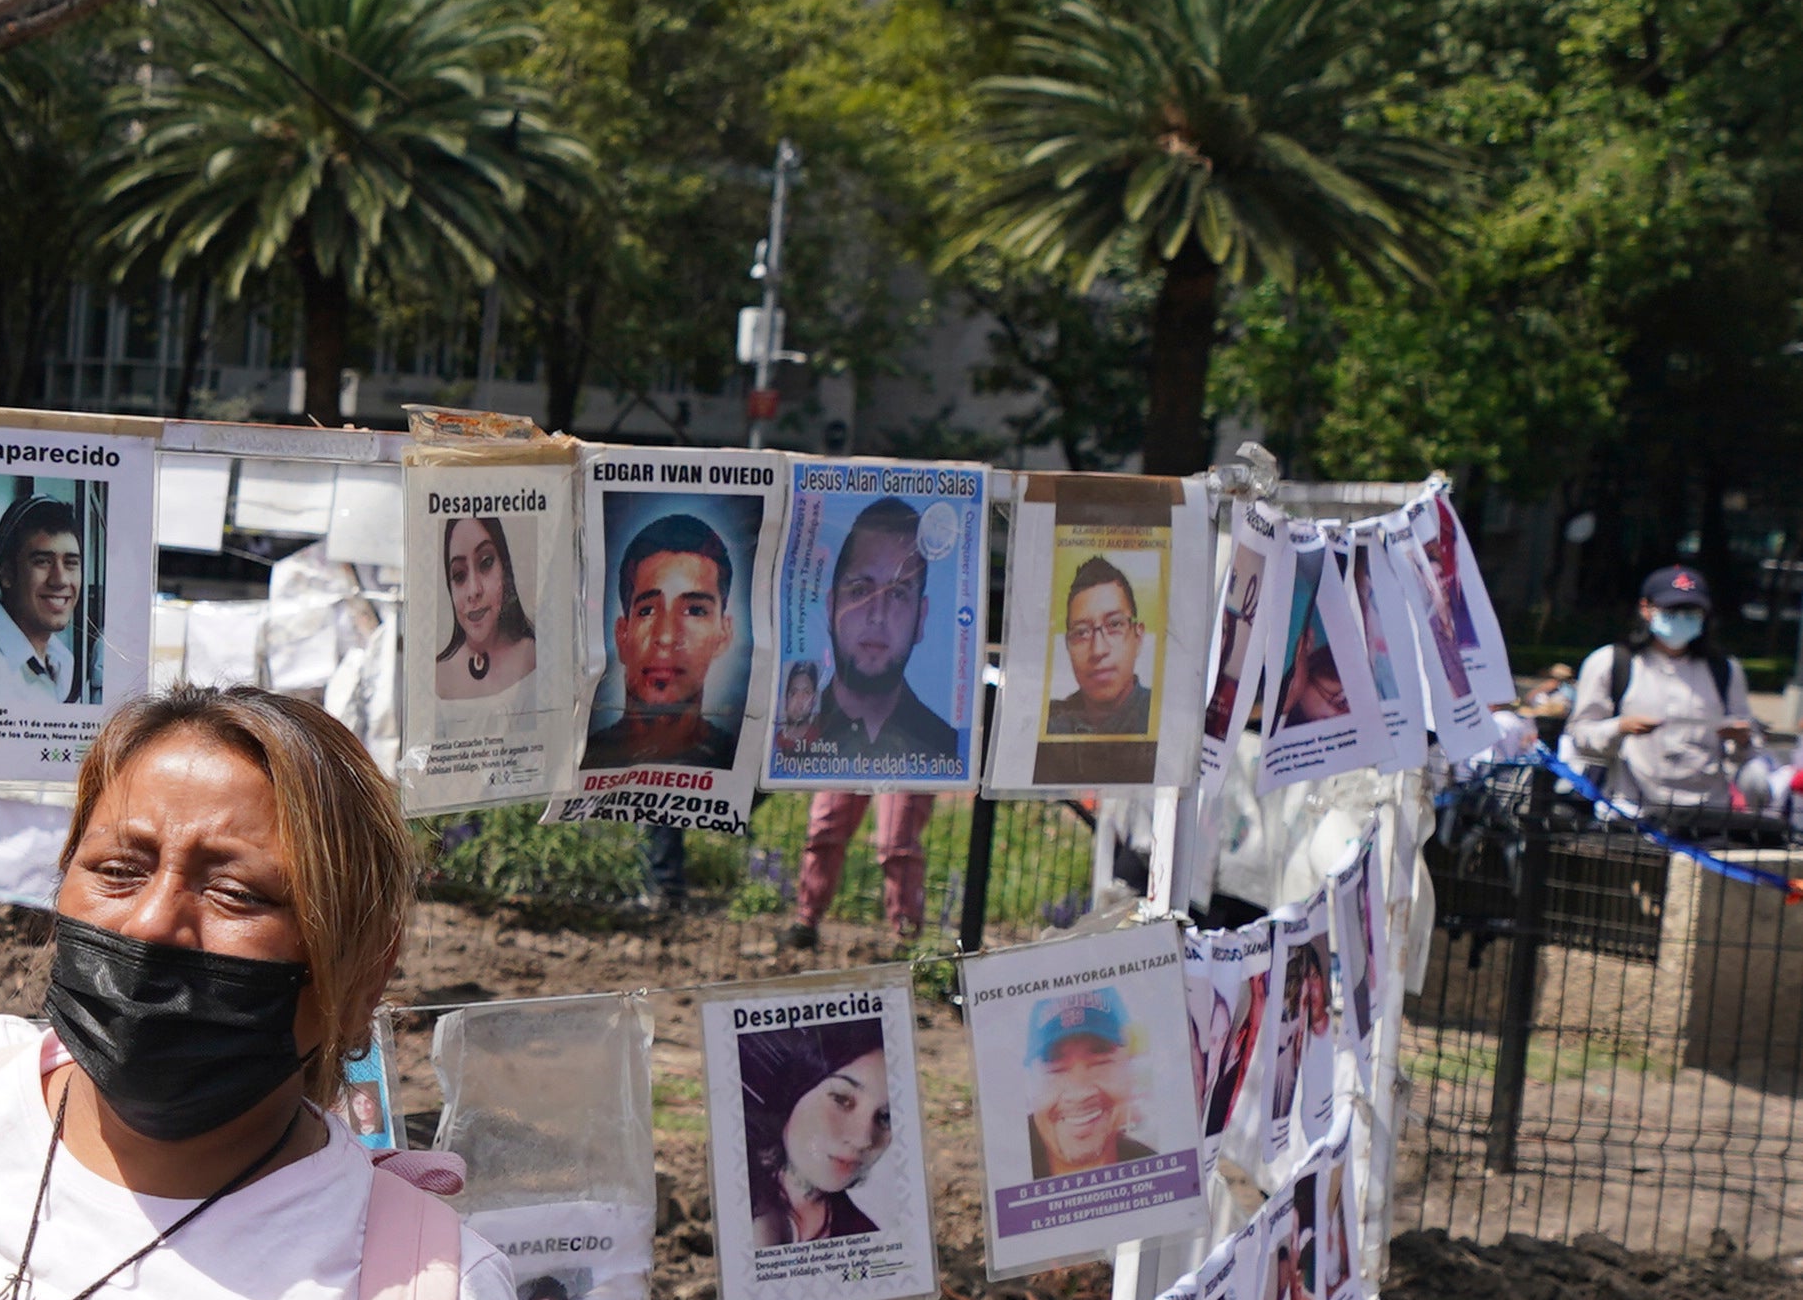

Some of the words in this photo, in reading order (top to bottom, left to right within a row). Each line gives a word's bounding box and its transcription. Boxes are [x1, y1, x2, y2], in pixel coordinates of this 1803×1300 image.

[593, 463, 655, 484] EDGAR
[661, 463, 703, 484] IVAN
[709, 465, 775, 487] OVIEDO
[800, 466, 843, 491] Jesús
[846, 470, 877, 493] Alan
[882, 470, 934, 495] Garrido
[937, 470, 975, 496] Salas
[428, 491, 547, 518] Desaparecida
[794, 739, 806, 752] 31
[810, 740, 838, 754] años
[853, 754, 869, 773] de
[873, 754, 907, 775] edad
[910, 755, 926, 775] 35
[931, 754, 963, 776] años
[584, 770, 713, 791] DESAPARECIÓ
[974, 987, 1003, 1006] JOSE
[1007, 979, 1049, 997] OSCAR
[1053, 967, 1116, 988] MAYORGA
[1120, 953, 1178, 976] BALTAZAR
[733, 991, 884, 1031] Desaparecida
